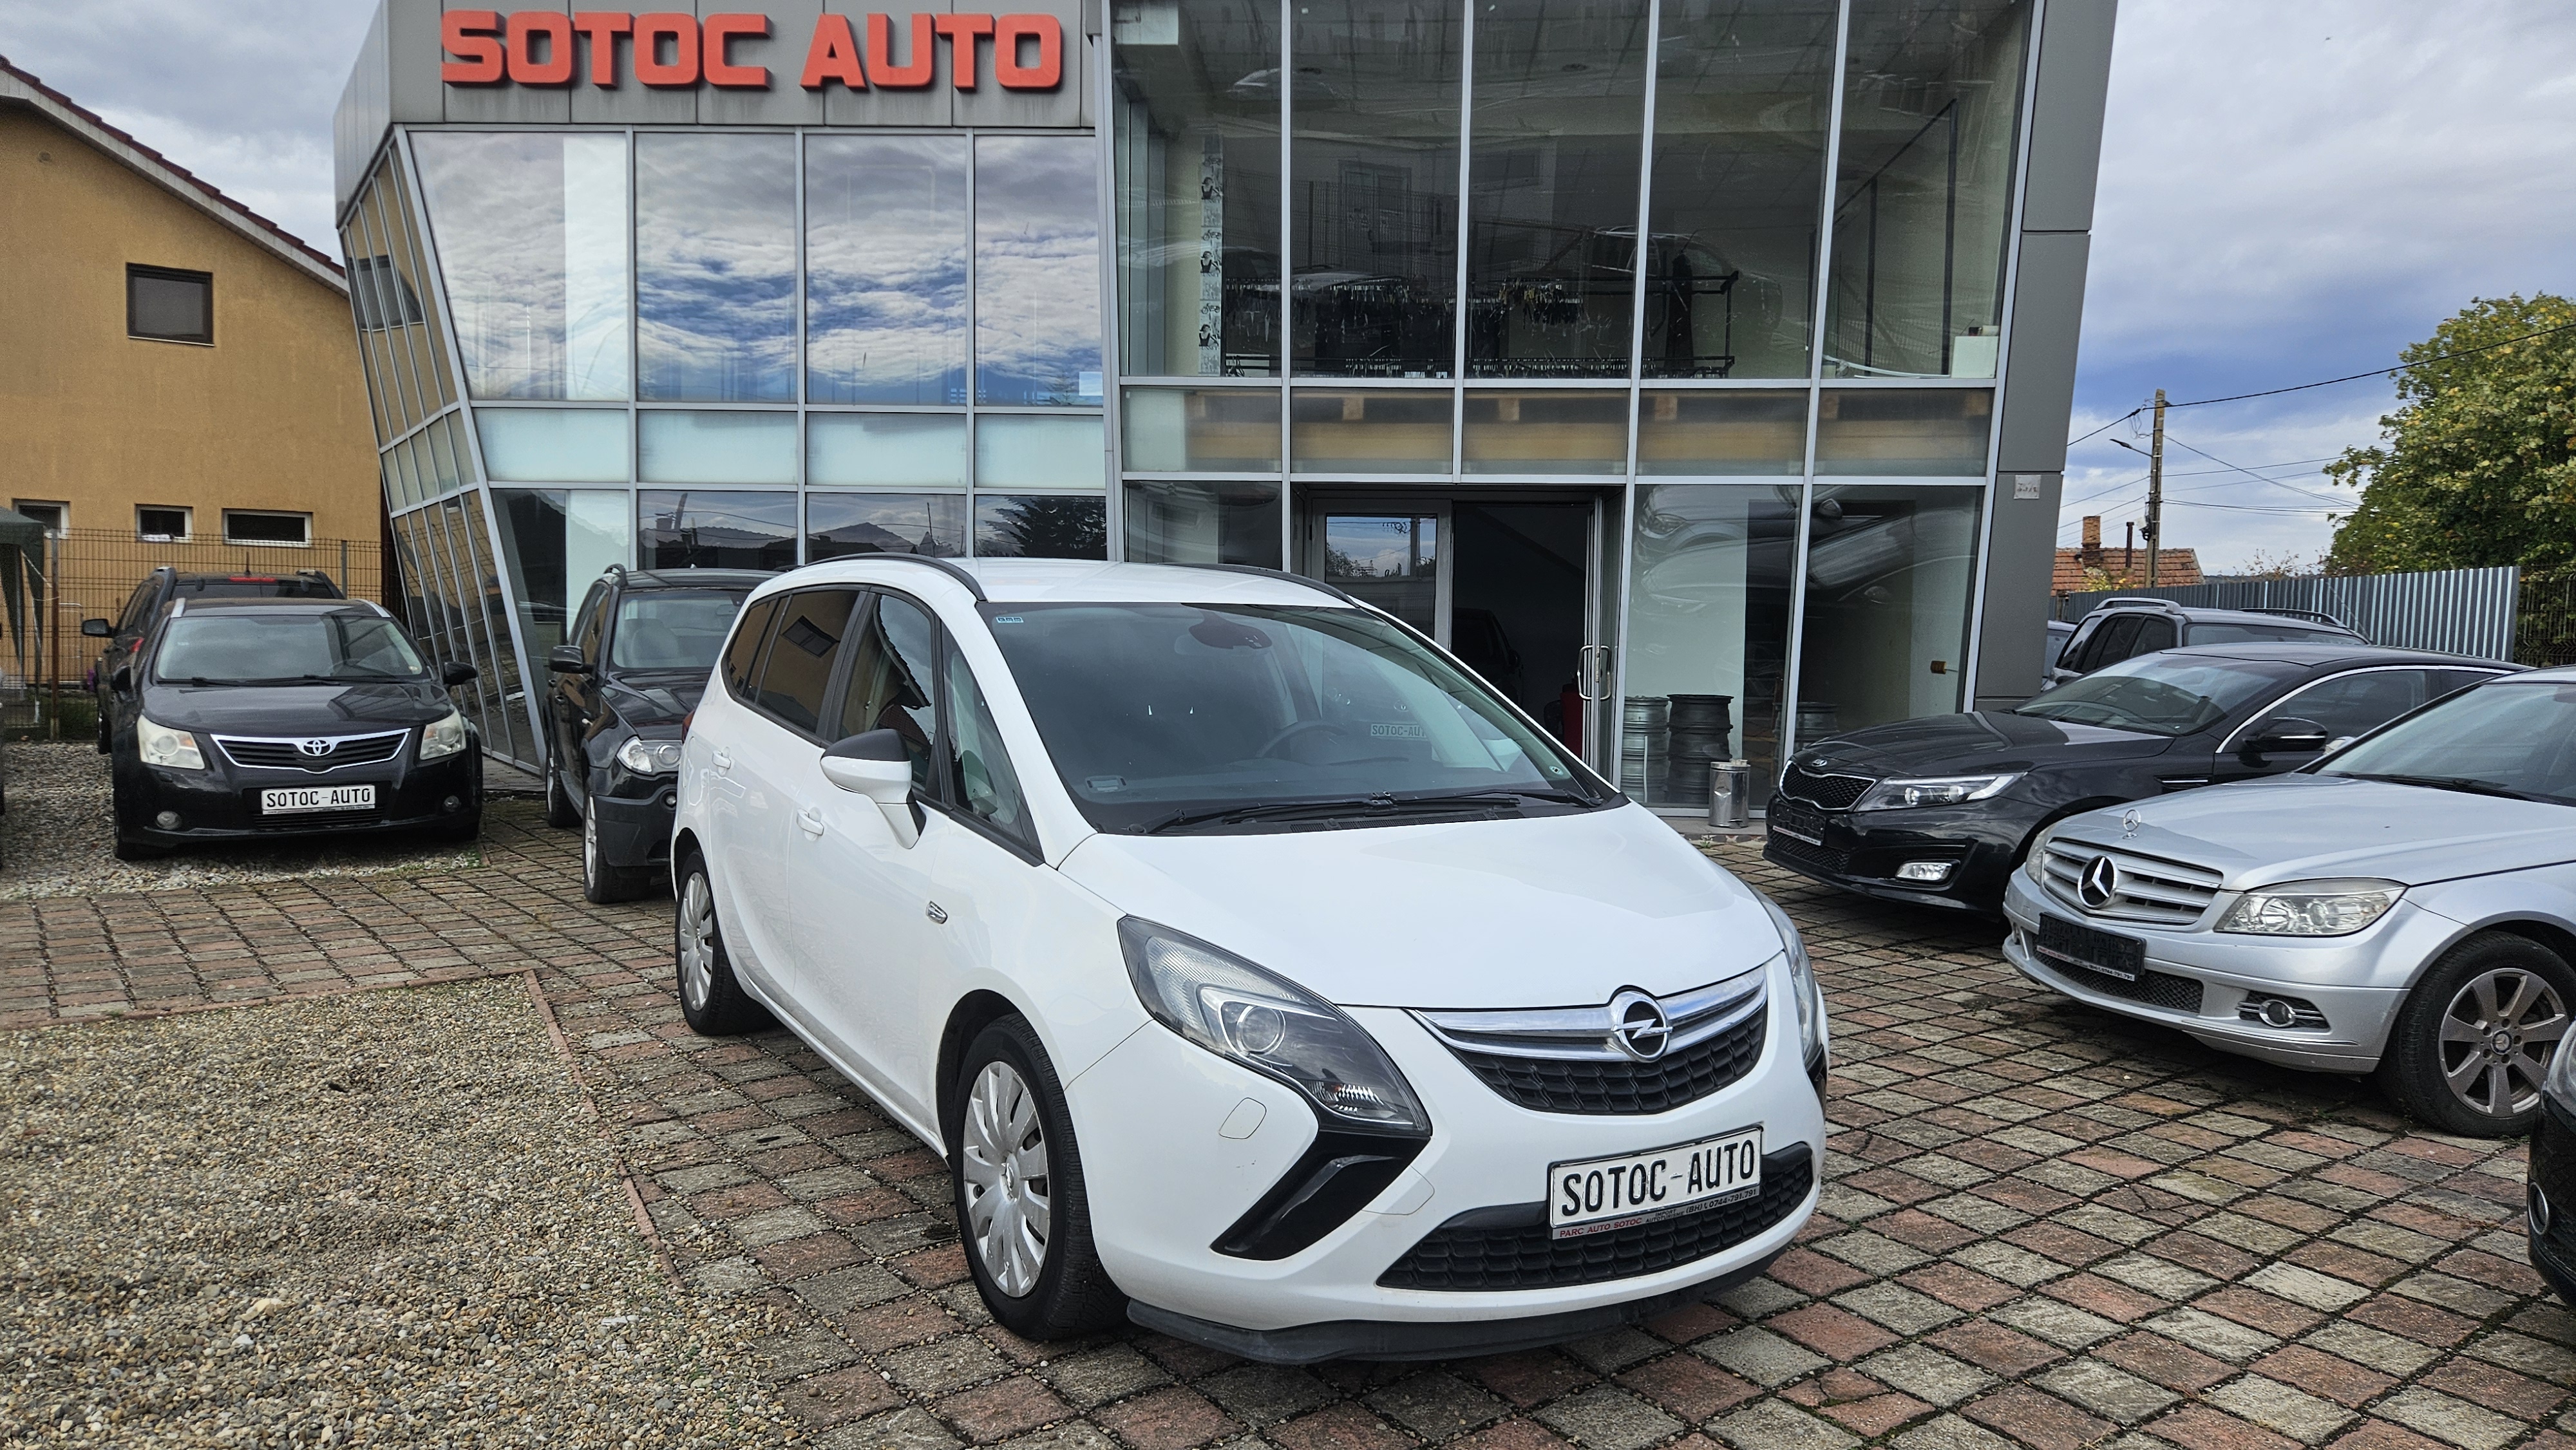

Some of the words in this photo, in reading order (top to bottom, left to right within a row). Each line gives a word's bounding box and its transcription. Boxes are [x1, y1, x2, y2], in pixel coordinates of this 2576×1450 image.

[441, 10, 770, 88] SOTOC
[800, 14, 1061, 89] AUTO
[1686, 1202, 1703, 1214] (BH)
[1709, 1189, 1756, 1208] 0744-791.791
[1560, 1228, 1584, 1237] PARC
[1587, 1223, 1610, 1233] AUTO
[1614, 1218, 1642, 1228] SOTOC
